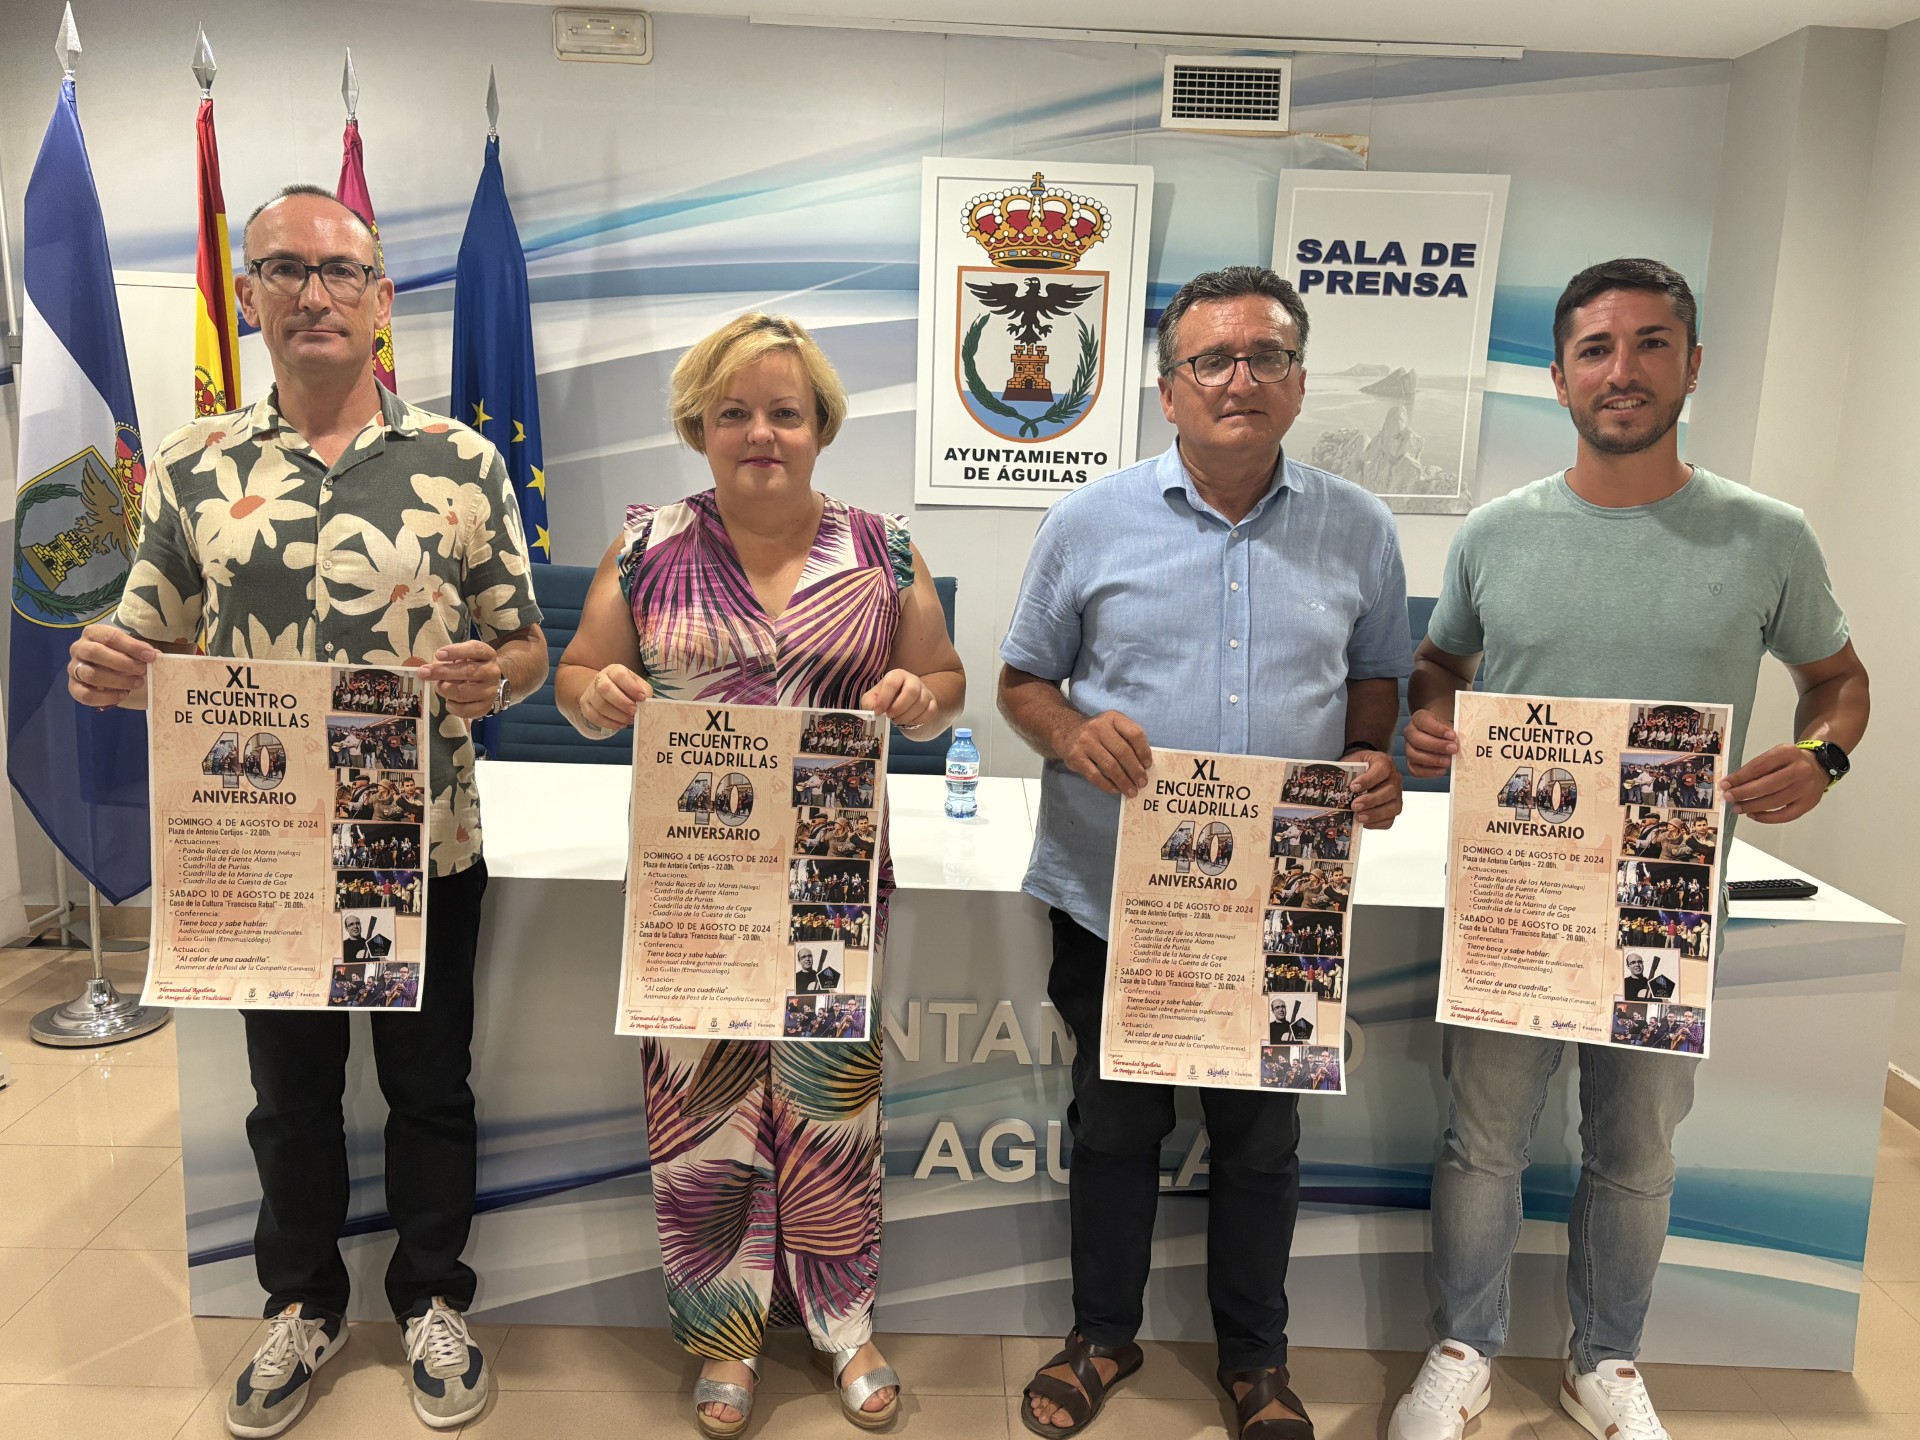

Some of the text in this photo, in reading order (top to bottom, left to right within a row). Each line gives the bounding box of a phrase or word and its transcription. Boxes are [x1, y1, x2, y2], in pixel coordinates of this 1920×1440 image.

[1296, 239, 1476, 268] SALA DE
[1298, 270, 1468, 298] PRENSA
[944, 448, 1108, 465] AYUNTAMIENTO
[964, 465, 1087, 483] DE ÁGUILAS
[226, 666, 260, 689] XL
[187, 690, 297, 709] ENCUENTRO
[175, 709, 309, 728] DE CUADRILLAS
[705, 710, 735, 732] XL
[1525, 703, 1557, 726] XL
[669, 732, 768, 751] ENCUENTRO
[1488, 726, 1592, 746] ENCUENTRO
[202, 732, 286, 790] 40
[657, 751, 778, 769] DE CUADRILLAS
[1476, 745, 1603, 764] DE CUADRILLAS
[1191, 759, 1220, 781] XL
[192, 790, 296, 805] ANIVERSARIO
[678, 772, 753, 826] 40
[1156, 780, 1250, 800] ENCUENTRO
[1497, 766, 1577, 824] 40
[1143, 799, 1259, 818] DE CUADRILLAS
[168, 818, 212, 826] DOMINGO
[1486, 821, 1584, 839] ANIVERSARIO
[666, 826, 760, 841] ANIVERSARIO
[644, 852, 683, 860] DOMINGO
[1161, 821, 1233, 876] 40
[1463, 845, 1503, 855] DOMINGO
[1528, 851, 1567, 860] AGOSTO
[1584, 855, 1604, 864] 2024
[1148, 874, 1238, 890] ANIVERSARIO
[1126, 898, 1163, 908] DOMINGO
[1186, 902, 1221, 912] AGOSTO
[640, 921, 673, 929] SABADO
[700, 923, 736, 931] AGOSTO
[1460, 914, 1493, 924] SABADO
[1522, 920, 1559, 930] AGOSTO
[1563, 924, 1573, 932] DE
[1576, 925, 1596, 934] 2024
[1120, 968, 1152, 976] SABADO
[1178, 970, 1212, 980] AGOSTO
[1227, 974, 1245, 982] 2024
